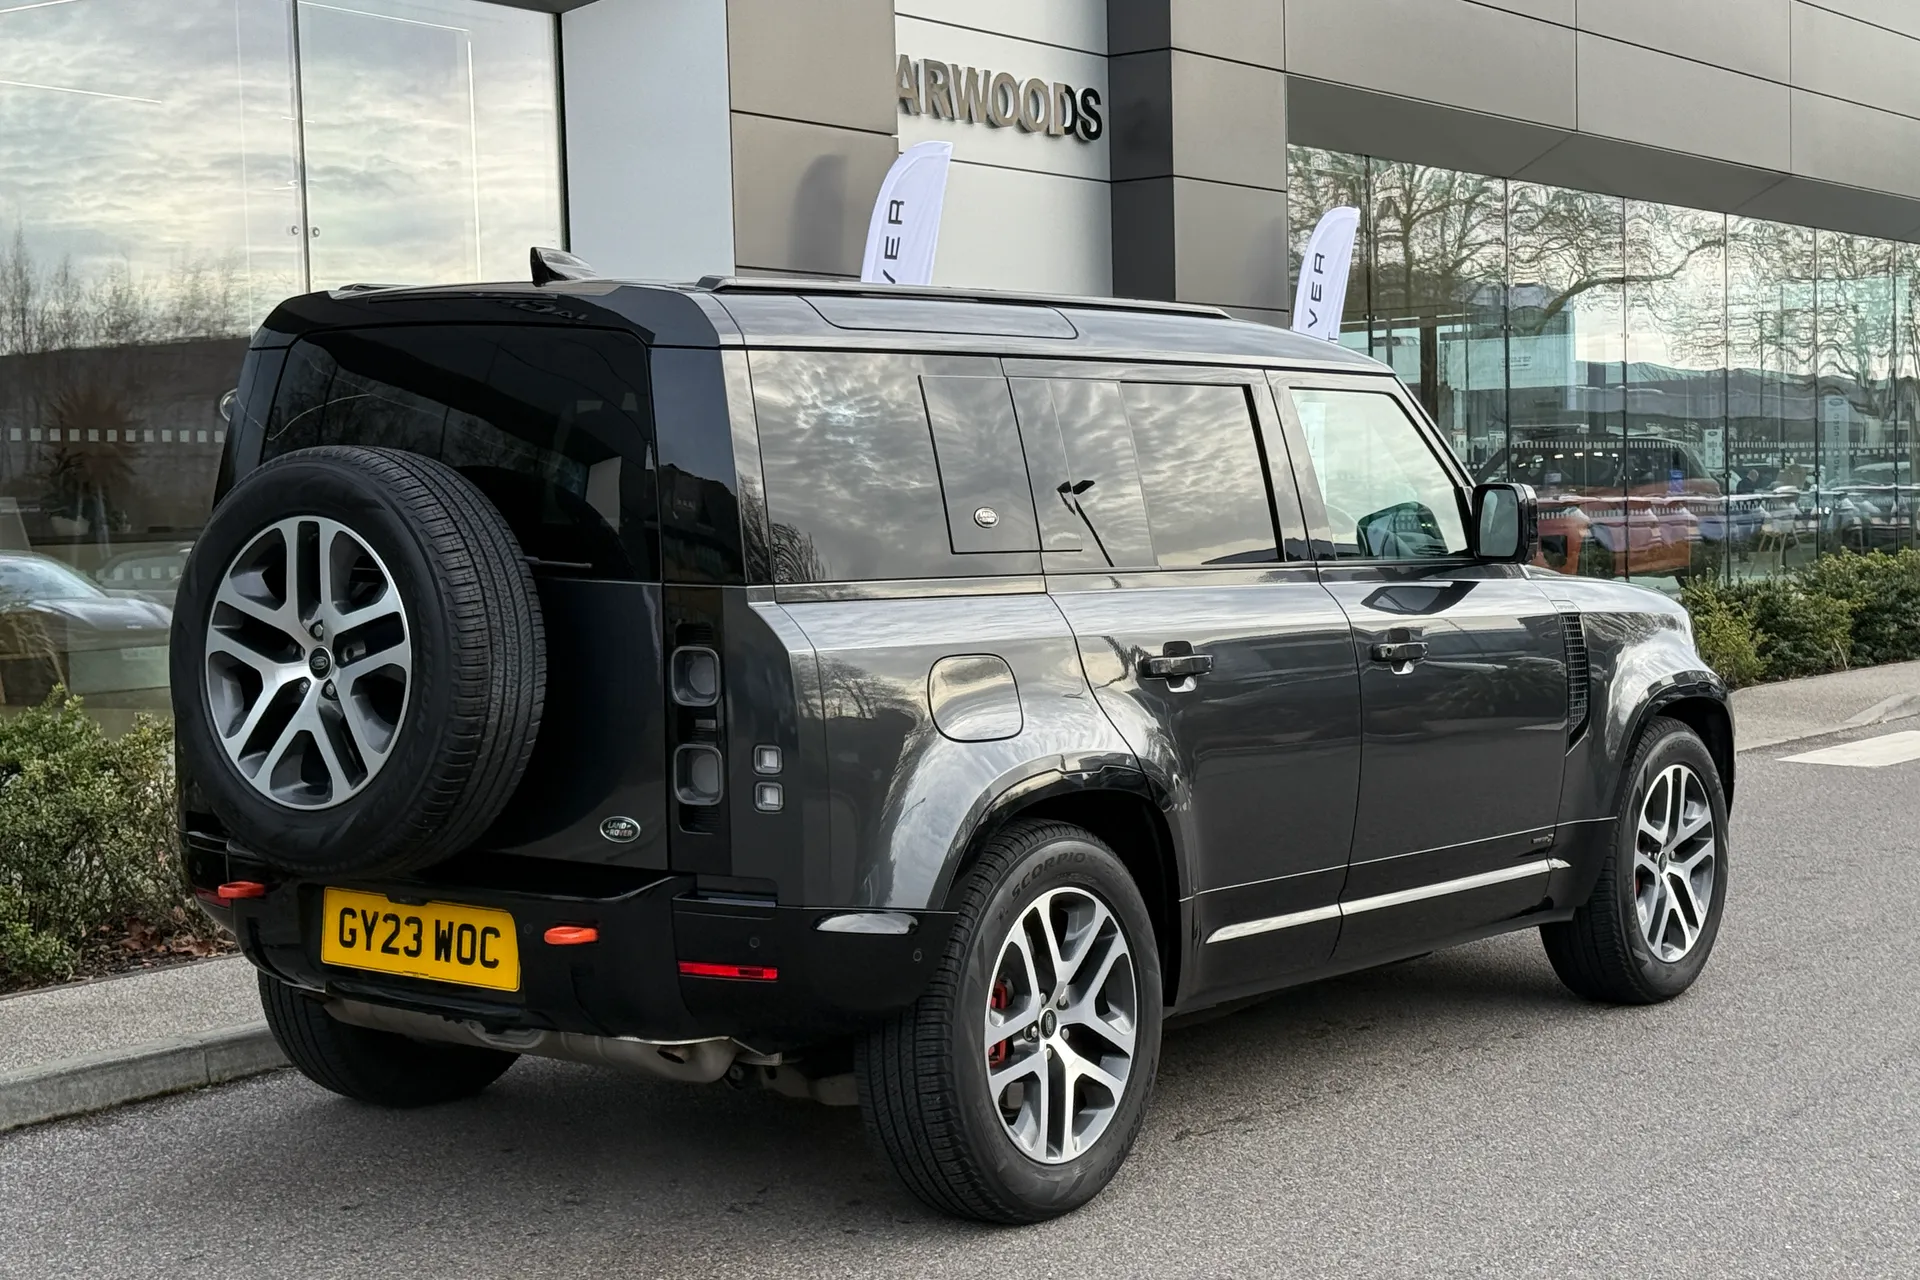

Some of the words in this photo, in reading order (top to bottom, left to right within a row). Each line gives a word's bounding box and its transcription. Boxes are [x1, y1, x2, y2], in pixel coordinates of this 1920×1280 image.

[896, 54, 1103, 142] ARWOODS
[1307, 252, 1326, 329] VER
[607, 821, 627, 829] LAND
[609, 829, 633, 837] ROVER
[338, 907, 423, 958] GY23
[434, 919, 501, 969] WOC
